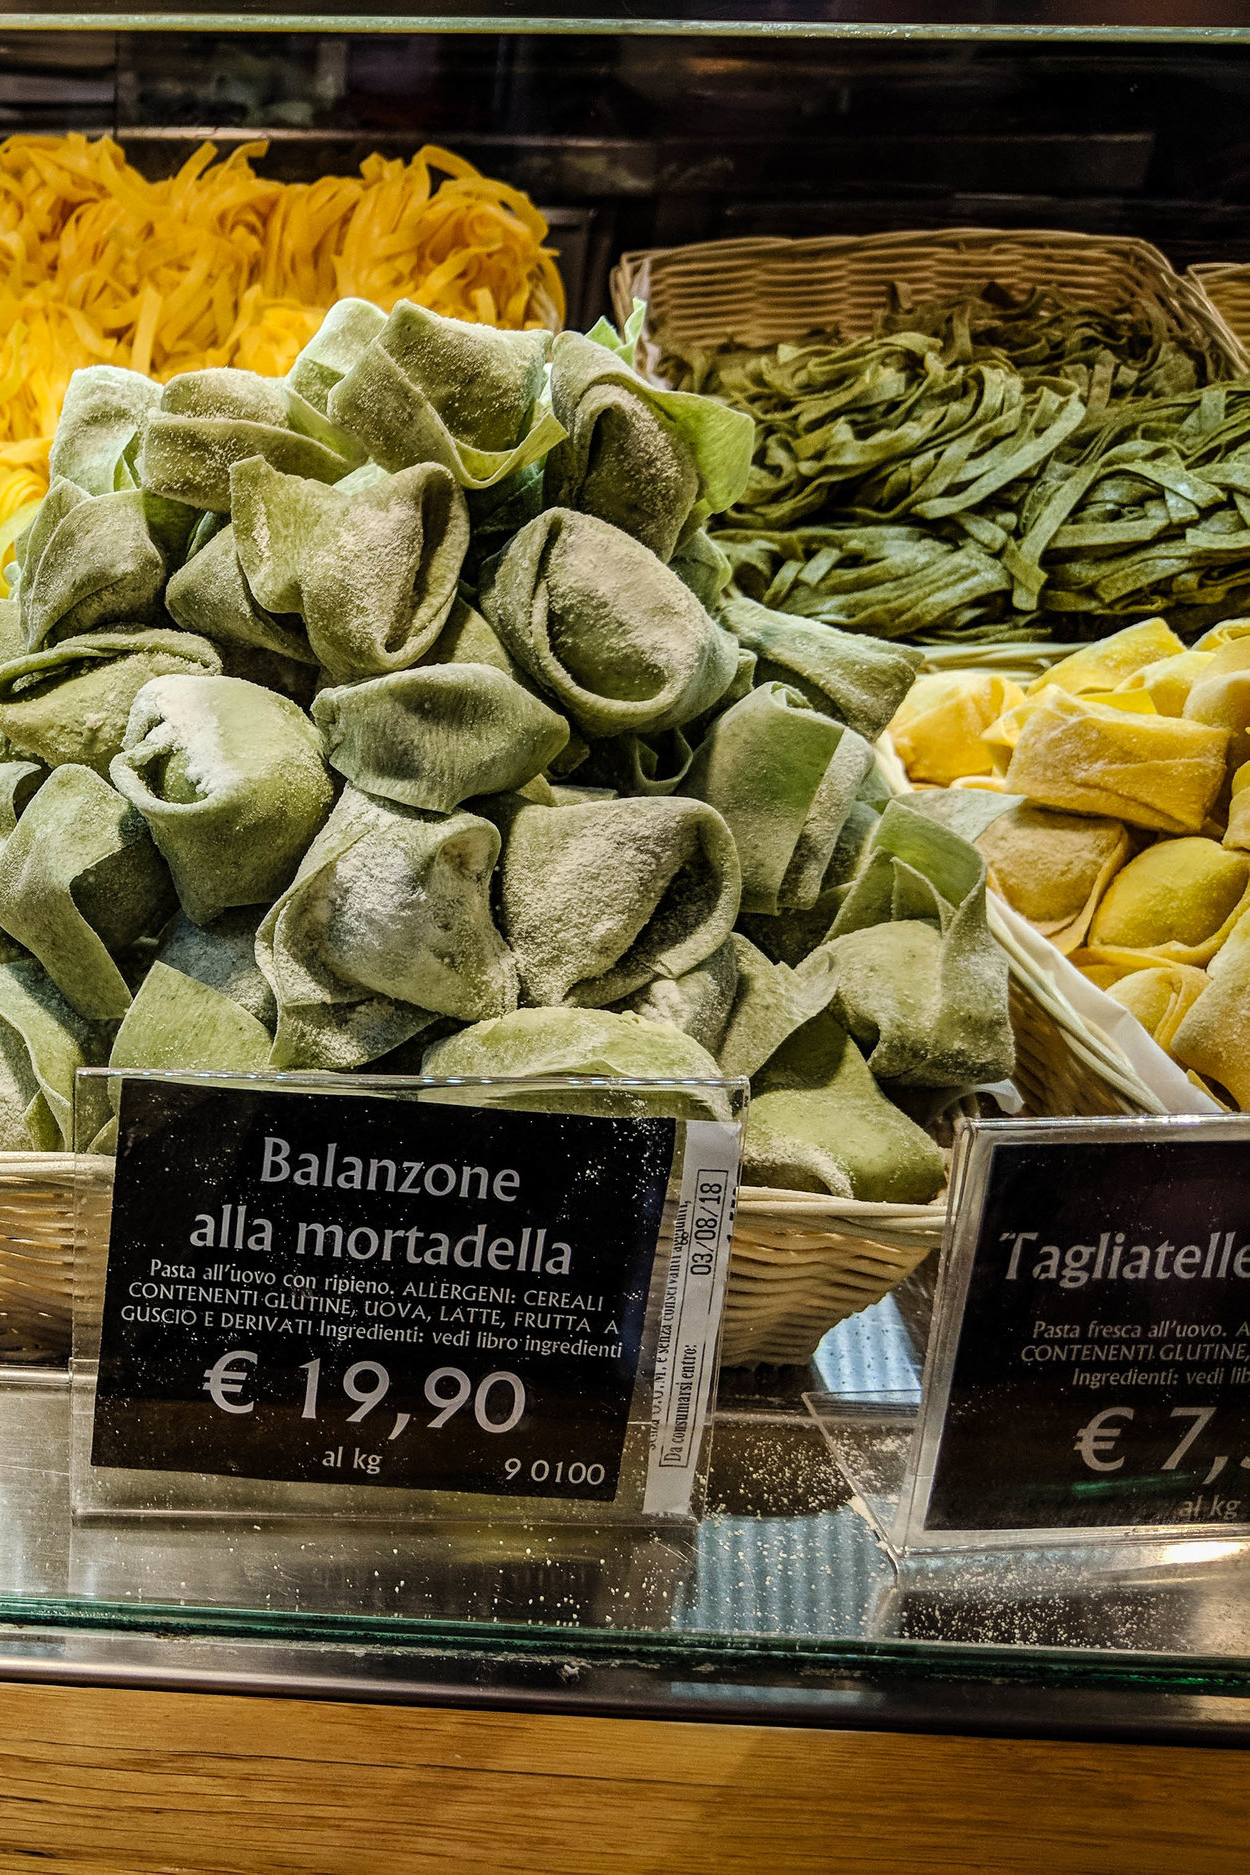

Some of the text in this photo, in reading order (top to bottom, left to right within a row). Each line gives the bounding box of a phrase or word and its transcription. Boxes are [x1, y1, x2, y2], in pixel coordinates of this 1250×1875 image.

[258, 1136, 521, 1202] Balanzone
[188, 1204, 575, 1277] alla mortadella
[998, 1231, 1250, 1289] Tagliatelle
[128, 1281, 620, 1335] CONTENENTI GLUTINE, UOVA, LATTE, FRUTTA A
[150, 1258, 604, 1312] Pasta all'uovo con ripieno. ALLERGENI: CEREALI
[121, 1305, 623, 1359] GUSCIO E DERIVATI Ingredienti: vedi libro ingredienti
[658, 1324, 672, 1355] senza
[664, 1182, 723, 1462] Da consumarsi entro: 03/08/18
[1032, 1320, 1080, 1338] Pasta
[1087, 1320, 1142, 1339] fresca
[1147, 1319, 1228, 1338] all'uovo.
[1020, 1343, 1154, 1362] CONTENENTI
[1072, 1366, 1179, 1389] Ingredienti:
[1186, 1366, 1225, 1385] vedi
[202, 1350, 527, 1440] € 19,90
[322, 1445, 382, 1475] al kg
[504, 1458, 606, 1487] 9 0100
[1073, 1406, 1250, 1485] € 7,
[1178, 1494, 1242, 1521] al kg
